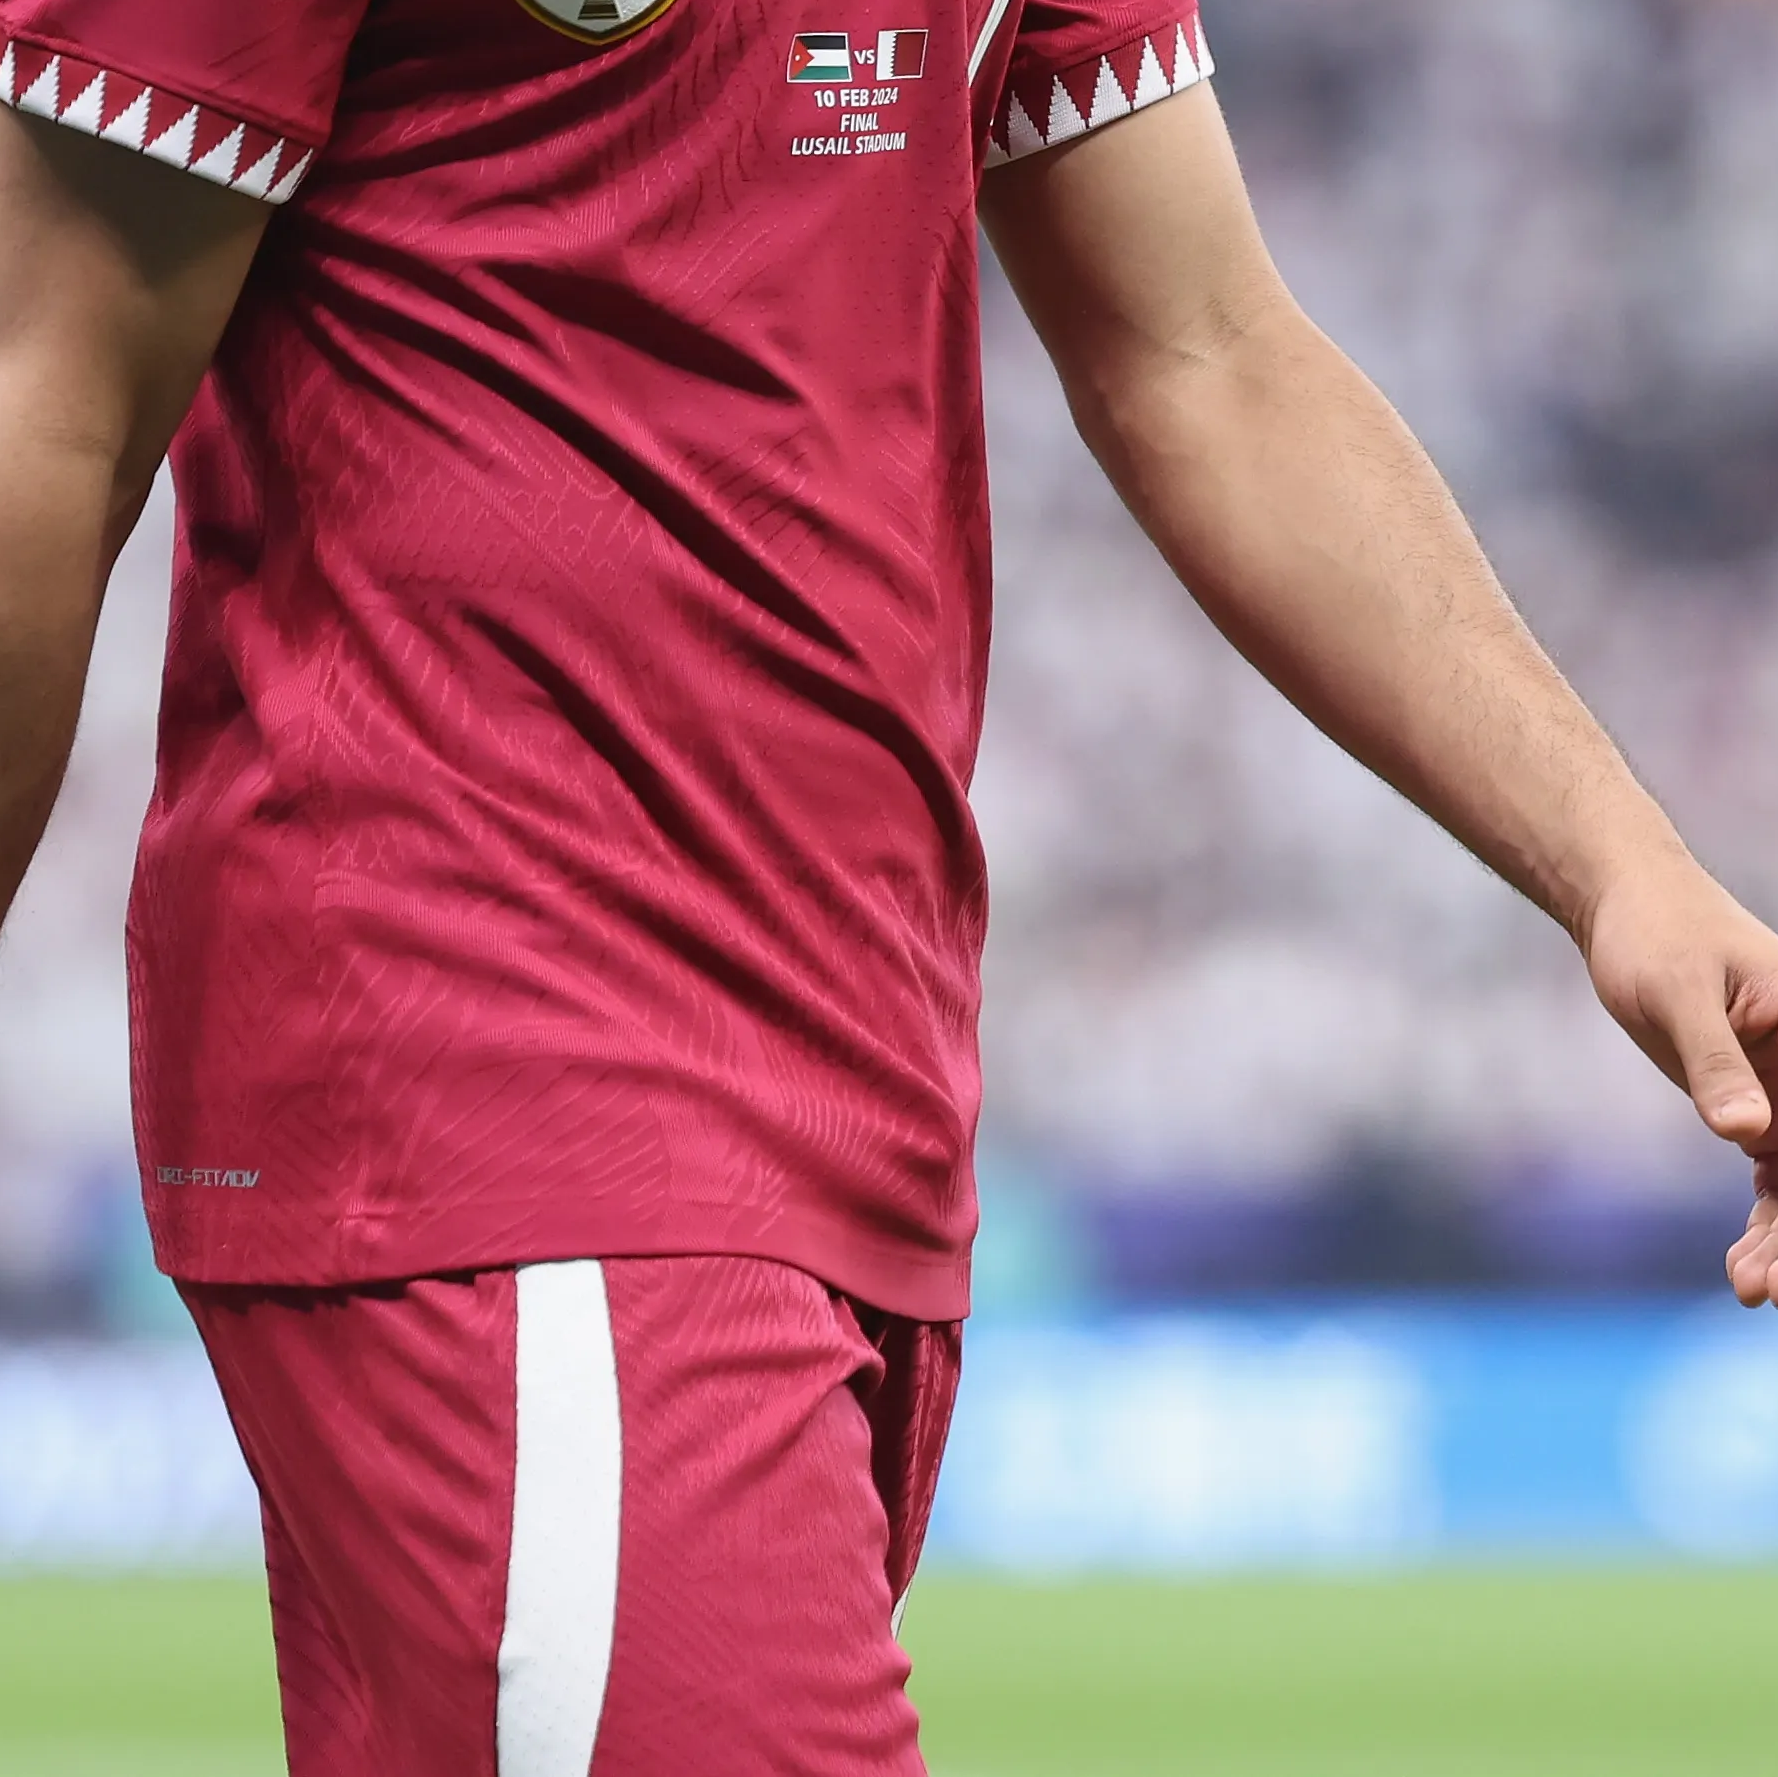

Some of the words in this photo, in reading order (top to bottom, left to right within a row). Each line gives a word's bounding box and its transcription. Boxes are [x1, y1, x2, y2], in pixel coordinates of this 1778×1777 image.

[814, 90, 835, 107] 10
[840, 89, 869, 107] FEB
[871, 87, 899, 105] 2024
[840, 113, 879, 132] FINAL
[791, 137, 852, 155] LUSAIL
[854, 132, 906, 154] STADIUM
